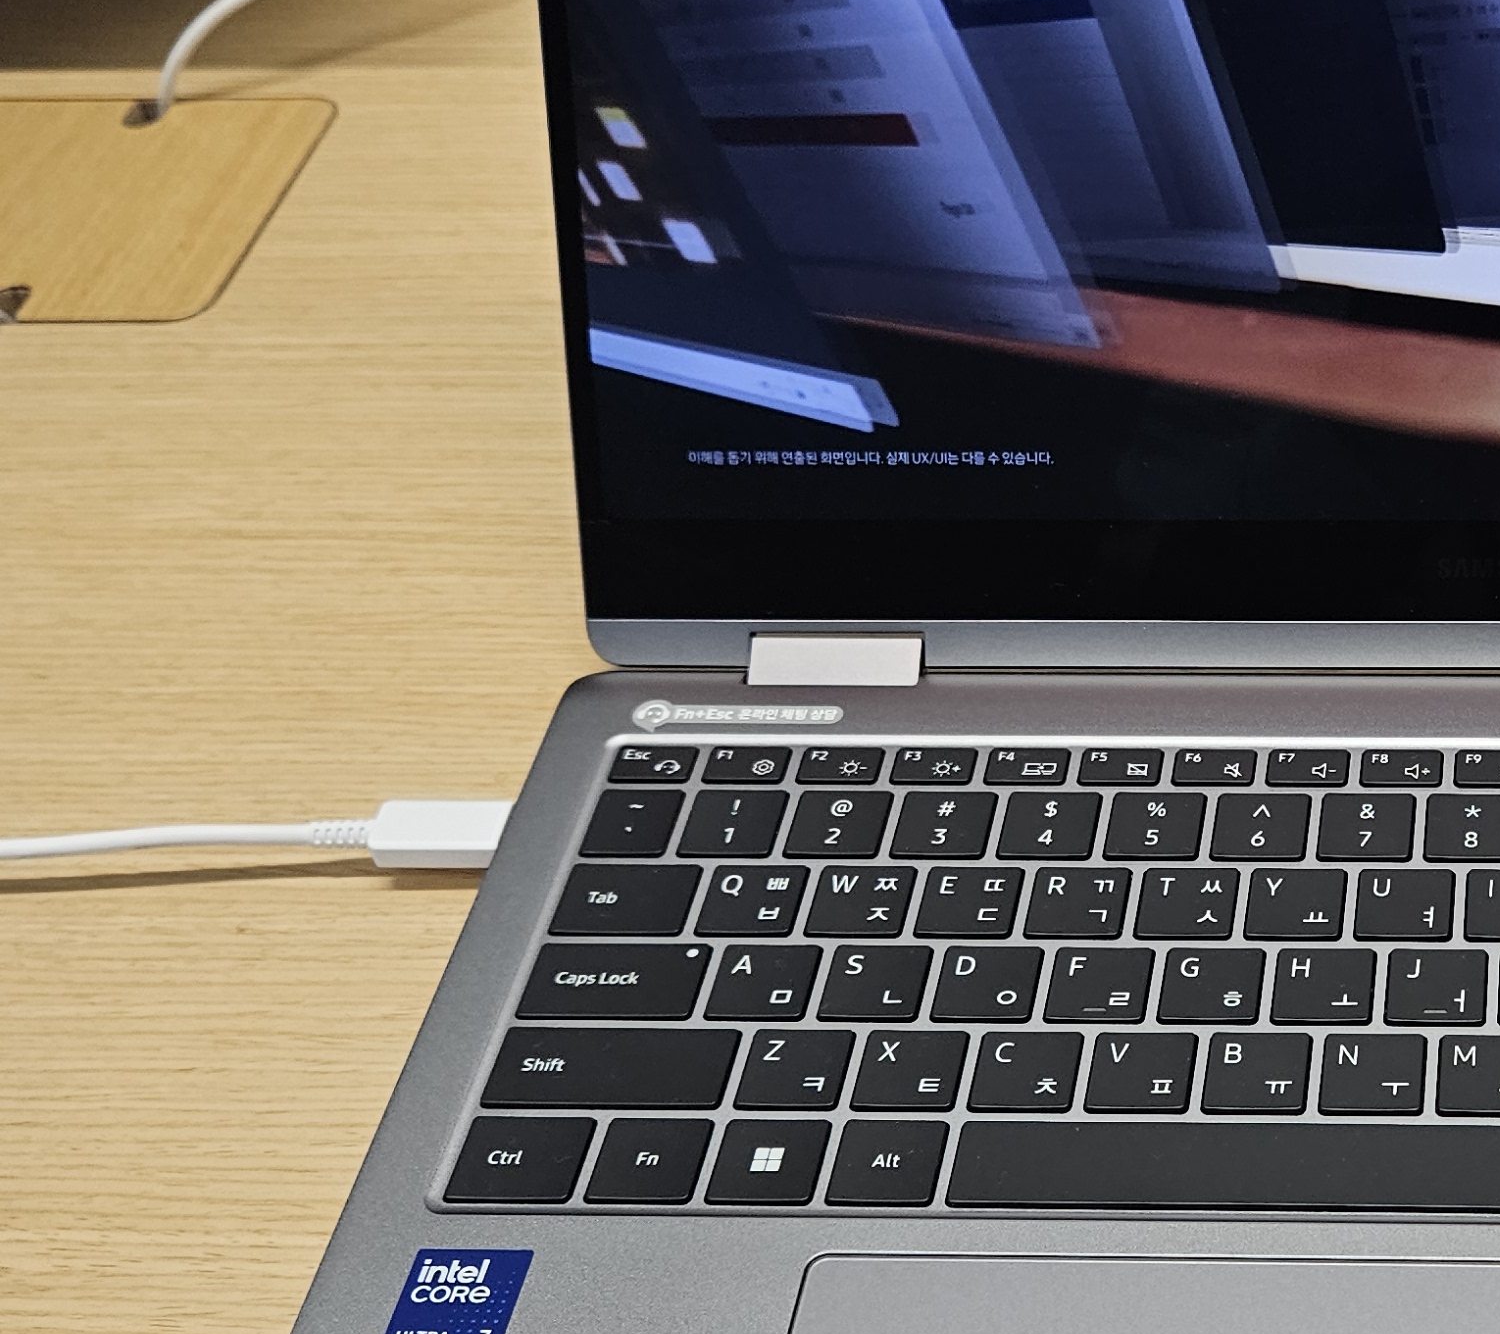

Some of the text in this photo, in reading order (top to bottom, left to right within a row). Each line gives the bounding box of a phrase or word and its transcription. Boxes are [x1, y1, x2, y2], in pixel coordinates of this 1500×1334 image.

[754, 451, 779, 465] 위해
[781, 451, 817, 465] 연출된
[820, 451, 883, 465] 화면입니다.
[886, 451, 909, 465] 실제
[912, 451, 959, 465] UX/UI는
[961, 451, 985, 465] 다를
[988, 451, 999, 465] 수
[1002, 451, 1054, 465] 있습니다.
[674, 709, 734, 720] Fn+Esc
[622, 748, 652, 761] Esc
[716, 749, 734, 760] F1
[810, 750, 829, 761] F2
[904, 750, 922, 761] F3
[997, 750, 1015, 762] F4
[1090, 751, 1108, 762] F5
[1184, 752, 1202, 763] F6
[1278, 752, 1296, 763] F7
[1371, 753, 1389, 764] F8
[1465, 753, 1482, 764] F9
[724, 827, 735, 844] 1
[824, 827, 841, 845] 2
[930, 828, 948, 845] 3
[1037, 829, 1053, 845] 4
[1144, 829, 1160, 846] 5
[1250, 830, 1266, 847] 6
[1358, 831, 1373, 847] 7
[1464, 831, 1478, 848] 8
[720, 874, 744, 897] Q
[831, 874, 860, 894] W
[939, 875, 959, 895] E
[1047, 876, 1067, 895] R
[1159, 877, 1176, 896] T
[1266, 877, 1284, 897] Y
[1372, 878, 1391, 897] U
[587, 891, 619, 904] Tab
[730, 954, 752, 975] A
[844, 954, 865, 975] S
[955, 955, 976, 976] D
[1068, 956, 1087, 977] F
[1180, 957, 1200, 978] G
[1290, 957, 1311, 979] H
[1406, 958, 1421, 979] J
[554, 971, 640, 988] Caps Lock
[762, 1039, 786, 1061] Z
[877, 1041, 901, 1062] X
[994, 1041, 1015, 1063] C
[1110, 1042, 1130, 1063] V
[1223, 1042, 1243, 1064] B
[1338, 1044, 1359, 1066] N
[1453, 1045, 1477, 1067] M
[520, 1057, 566, 1072] Shift
[487, 1149, 523, 1165] Ctrl
[635, 1151, 660, 1166] Fn
[871, 1152, 901, 1168] Alt
[417, 1259, 491, 1283] intel
